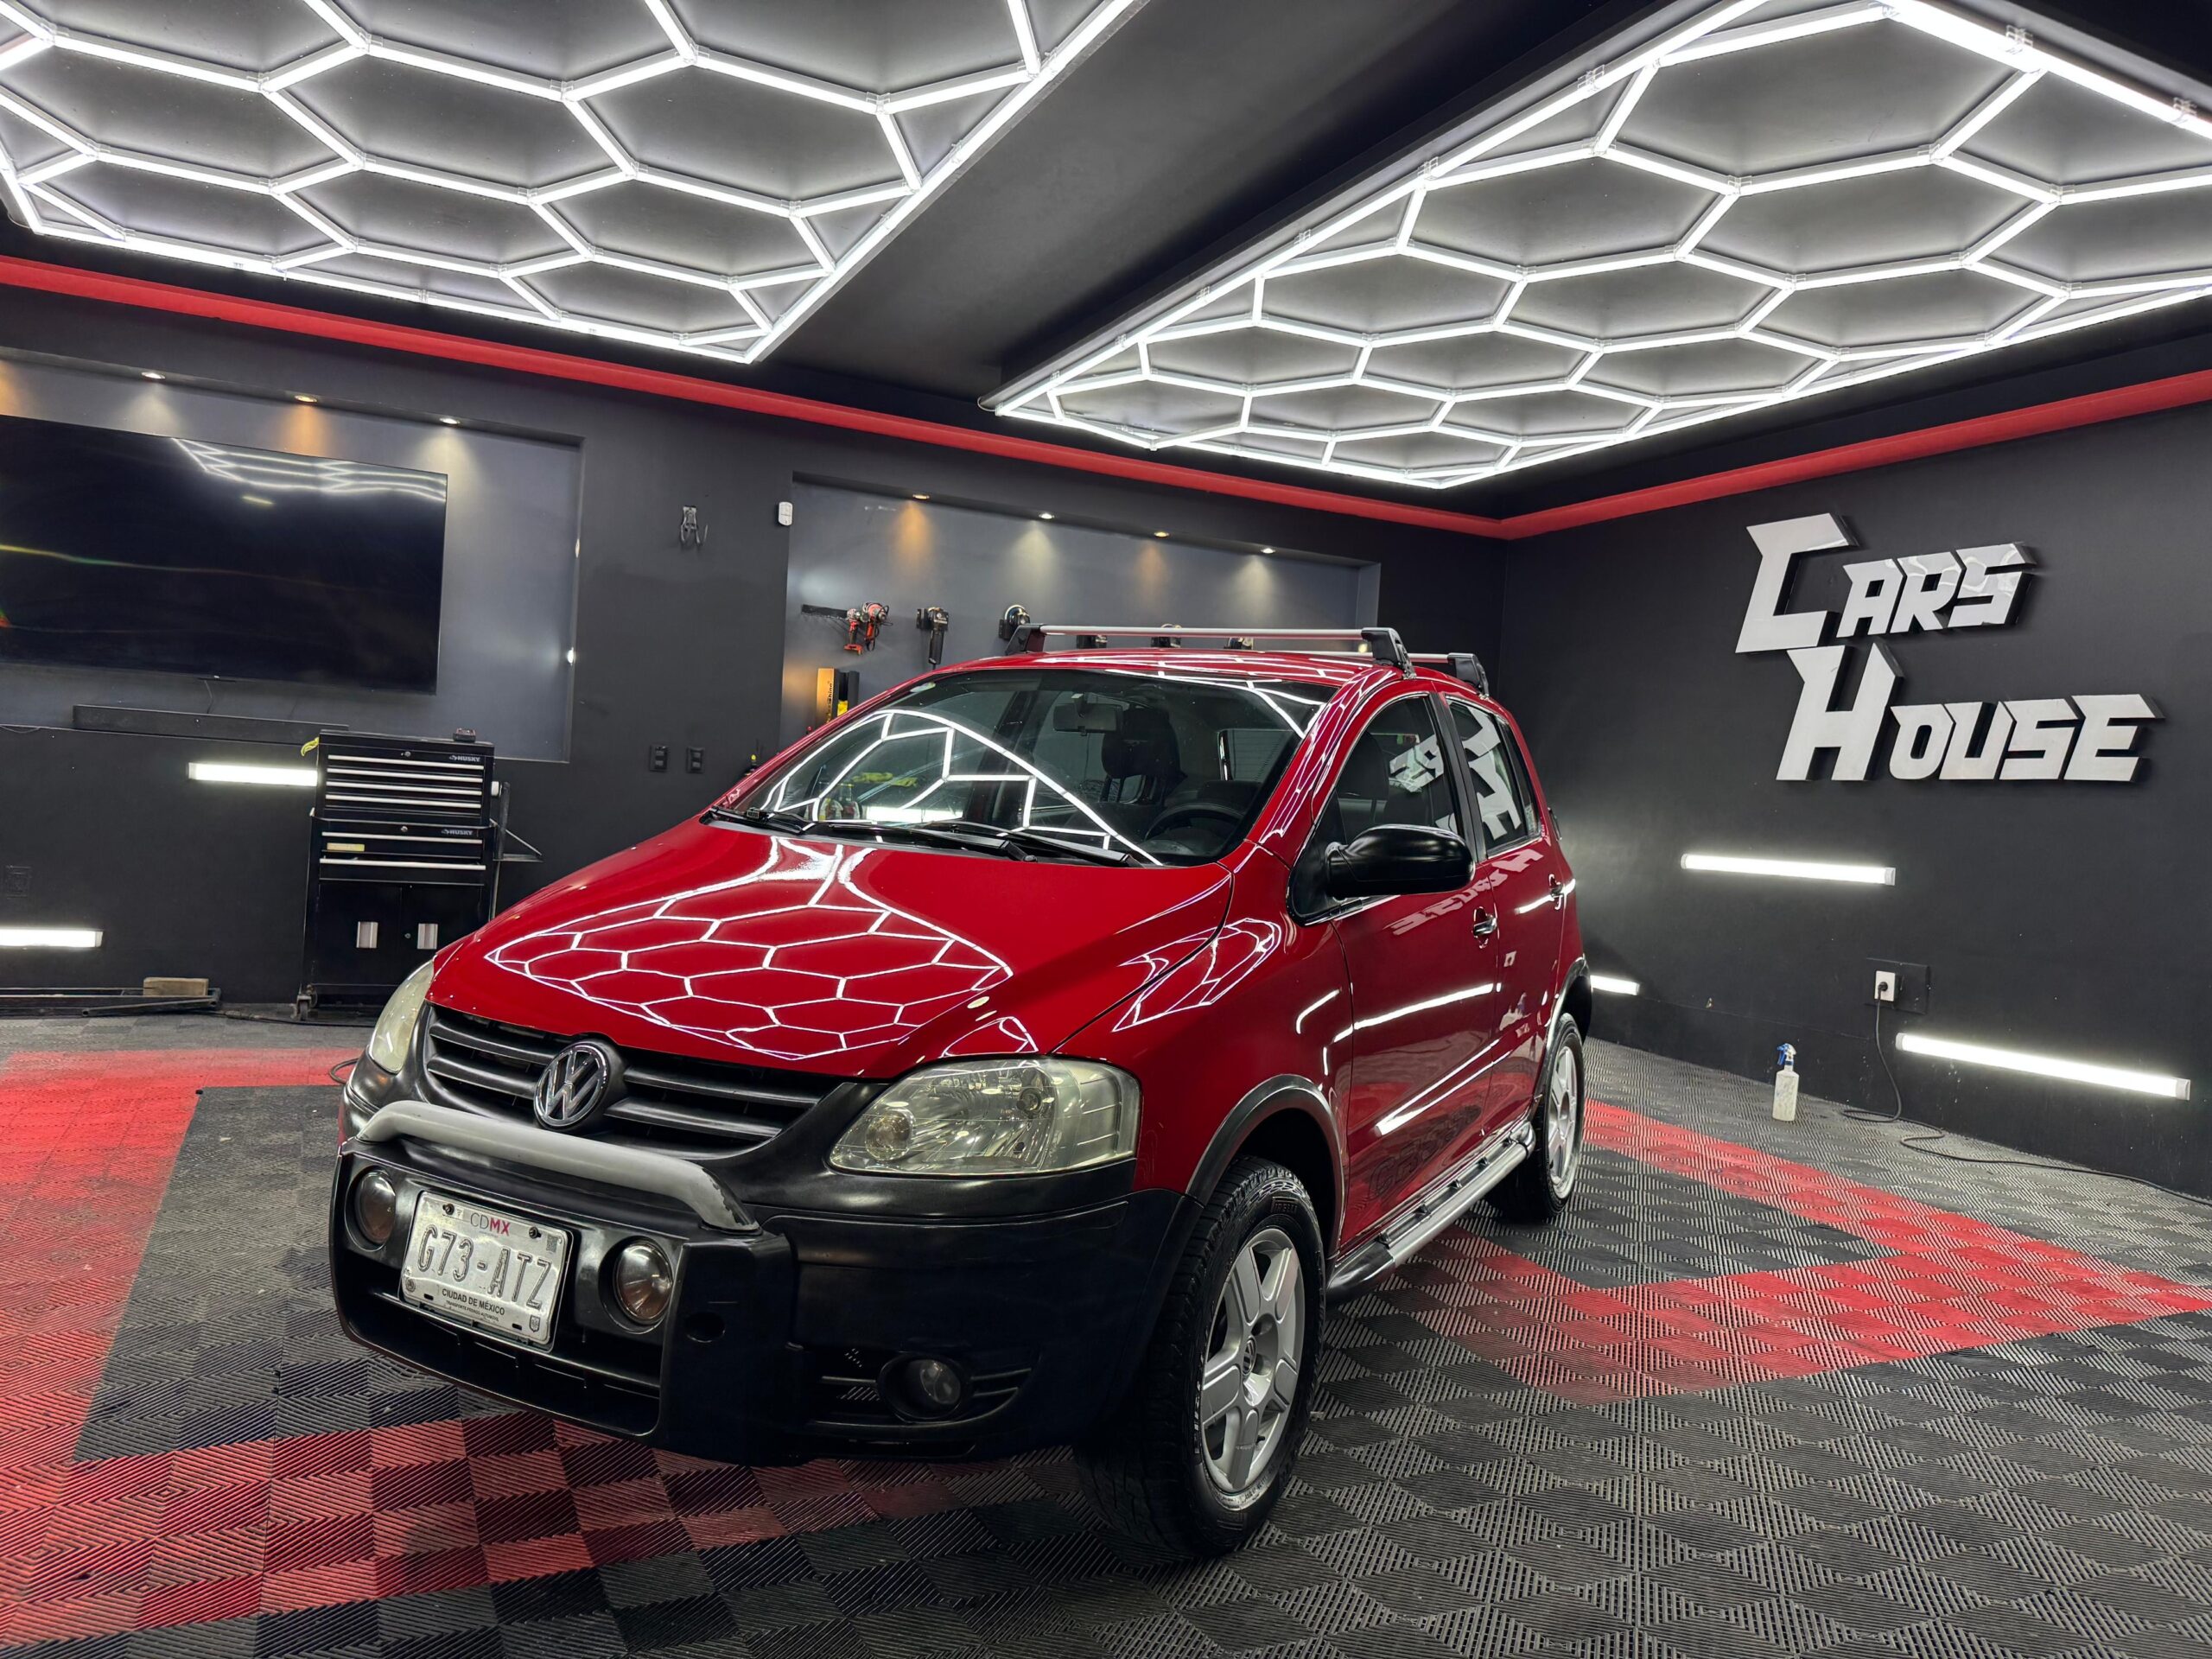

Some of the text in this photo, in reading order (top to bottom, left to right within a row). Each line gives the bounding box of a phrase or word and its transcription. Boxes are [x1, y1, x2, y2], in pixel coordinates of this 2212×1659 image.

[470, 1212, 512, 1236] CDMX
[417, 1224, 552, 1311] G73-ATZ
[442, 1288, 505, 1316] CIUDAD DE MÉXICO
